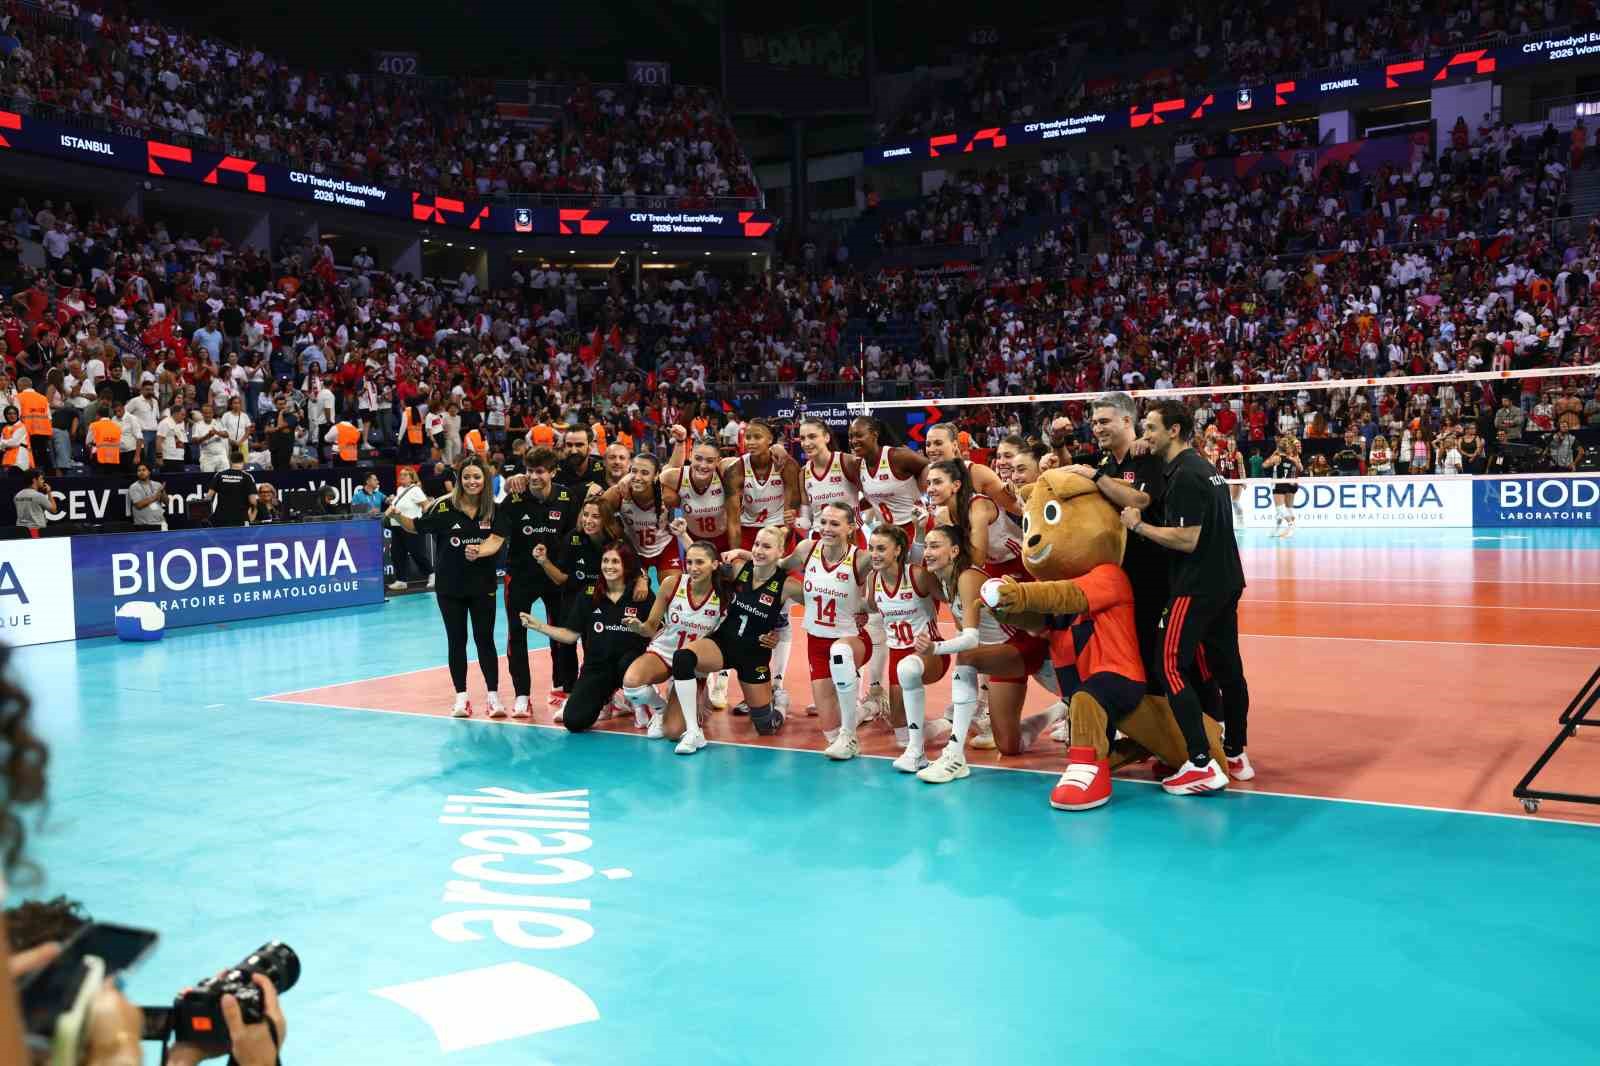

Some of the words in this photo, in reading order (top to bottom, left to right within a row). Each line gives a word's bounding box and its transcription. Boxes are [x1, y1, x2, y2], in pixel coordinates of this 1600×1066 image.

[1523, 42, 1543, 53] CEV
[1545, 34, 1587, 48] Trendyol
[1549, 48, 1573, 59] 2026
[377, 58, 416, 75] 402
[633, 67, 667, 85] 401
[1321, 79, 1359, 90] ISTANBUL
[1024, 123, 1039, 132] CEV
[1040, 118, 1068, 129] Trendyol
[1069, 114, 1106, 125] EuroVolley
[1043, 129, 1060, 138] 2026
[1060, 126, 1087, 136] Women
[61, 134, 115, 155] ISTANBUL
[289, 171, 308, 183] CEV
[309, 175, 344, 191] Trendyol
[345, 182, 386, 200] EuroVolley
[313, 189, 334, 202] 2026
[335, 193, 366, 207] Women
[630, 213, 647, 222] CEV
[648, 213, 682, 223] Trendyol
[682, 214, 724, 224] EuroVolley
[652, 224, 672, 232] 2026
[672, 224, 703, 232] Women
[777, 409, 795, 418] CEV
[813, 491, 845, 500] vodafone
[1254, 483, 1443, 509] BODERMA
[1500, 480, 1600, 507] BIOD
[44, 489, 111, 521] CEV
[695, 516, 716, 532] 18
[1336, 512, 1445, 521] DERMATOLOGIQUE
[1500, 511, 1592, 520] LABORATOIRE
[635, 527, 657, 547] 15
[112, 538, 357, 596] BIODERMA
[234, 581, 359, 604] DERMATOLOGIQUE
[814, 586, 849, 599] vodafone
[736, 599, 769, 619] vodafone
[813, 595, 837, 624] 14
[737, 614, 749, 637] 1
[890, 621, 914, 645] 10
[431, 786, 633, 950] arçelik
